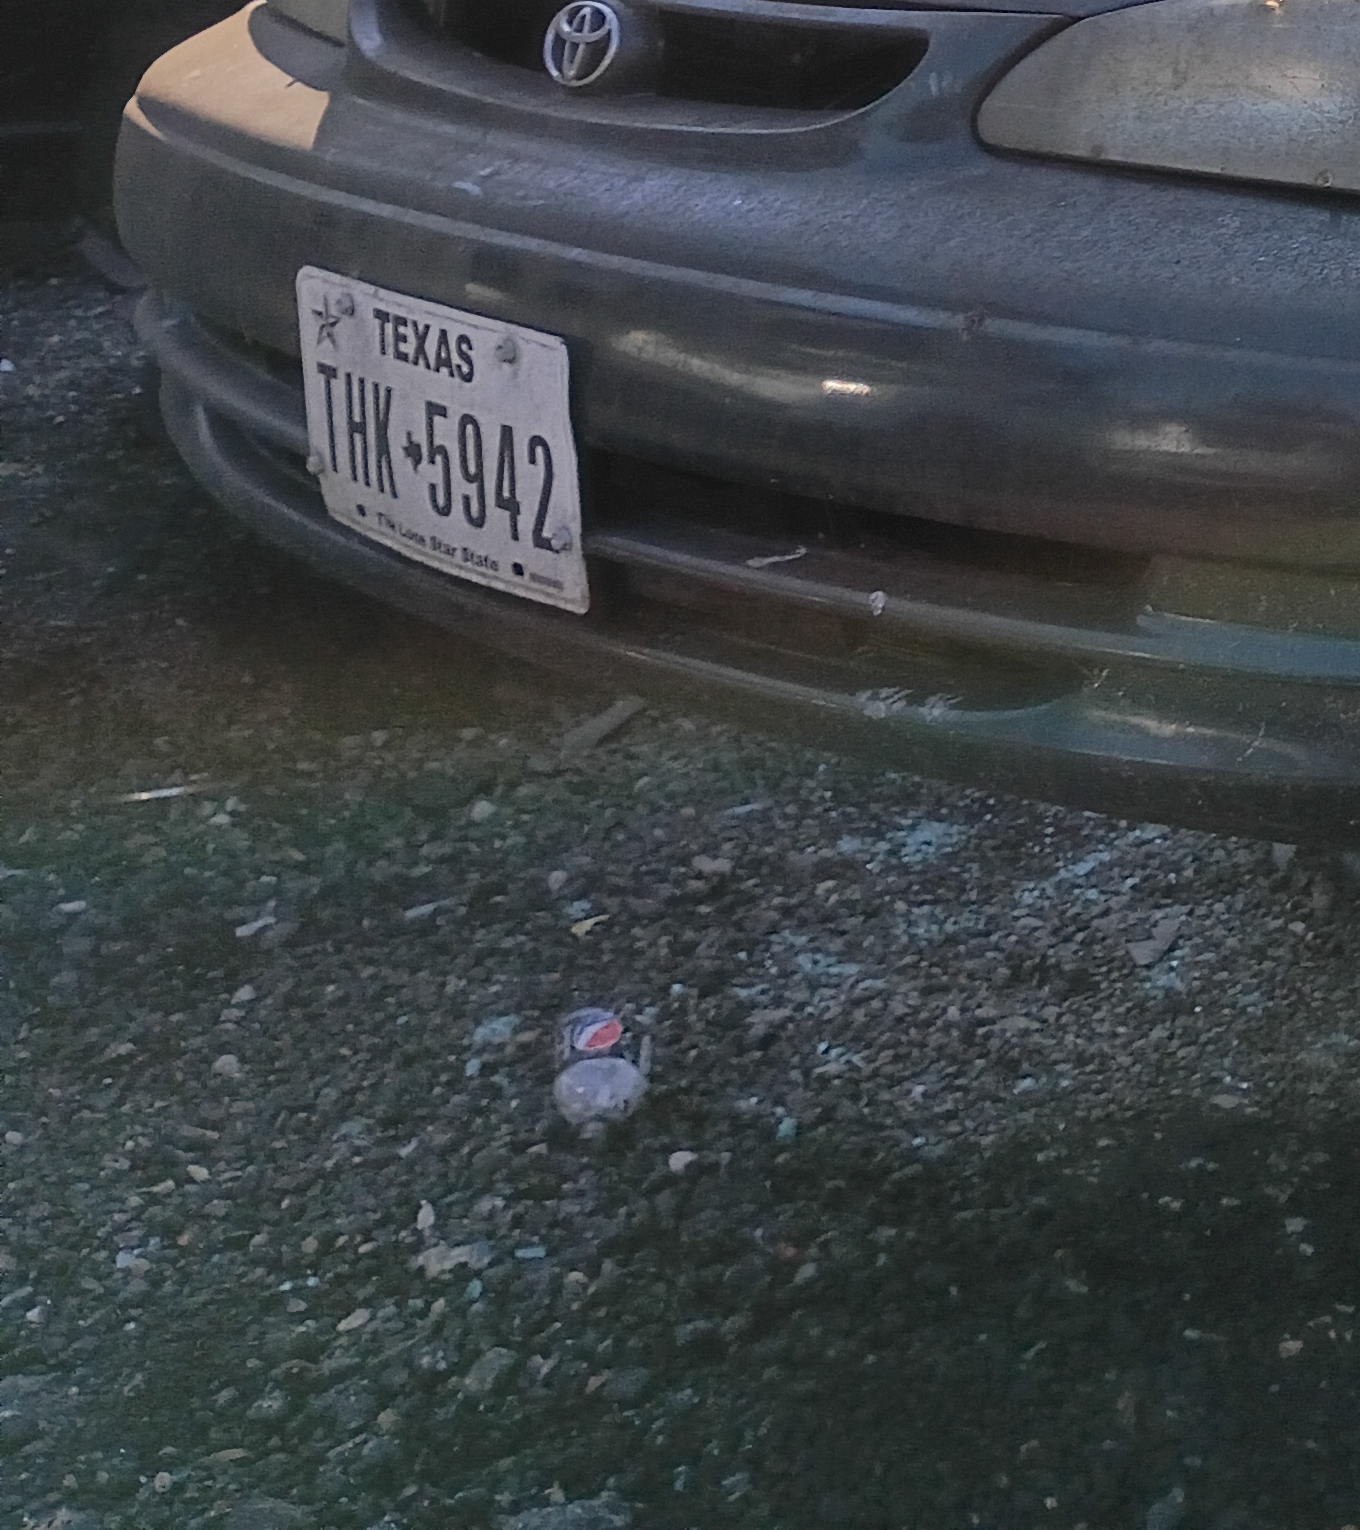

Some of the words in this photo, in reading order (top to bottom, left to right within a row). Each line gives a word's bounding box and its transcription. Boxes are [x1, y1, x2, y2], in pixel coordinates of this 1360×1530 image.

[373, 306, 475, 383] TEXAS
[430, 535, 457, 558] Star
[461, 547, 499, 572] State
